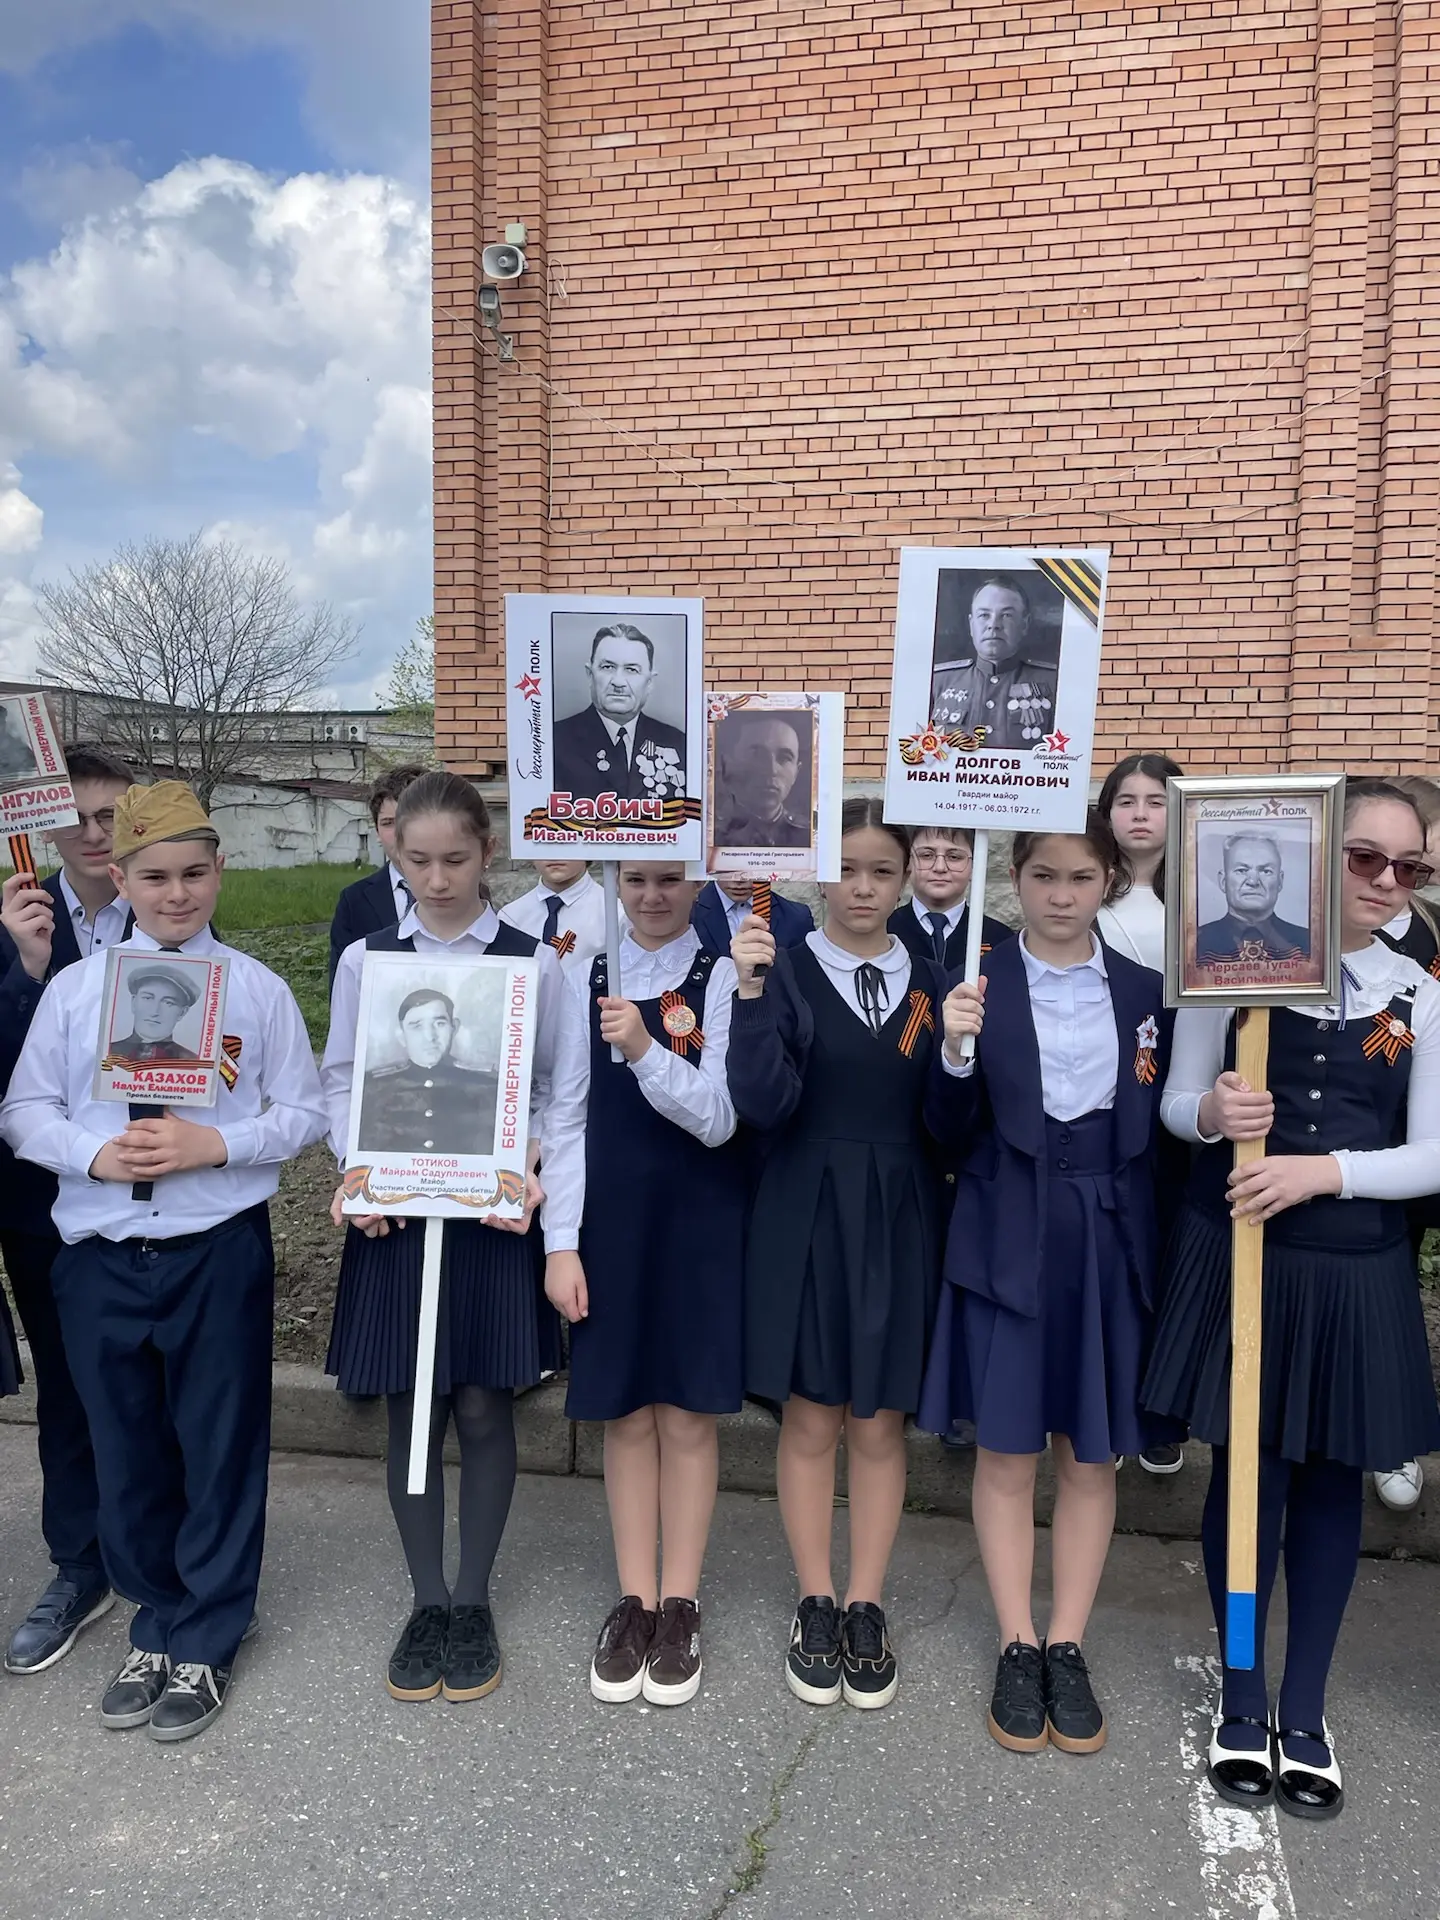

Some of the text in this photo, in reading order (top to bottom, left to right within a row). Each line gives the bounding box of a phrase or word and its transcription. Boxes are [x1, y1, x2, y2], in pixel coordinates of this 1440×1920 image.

[27, 696, 58, 772] БЕССМЕРТНЫЙ ПОЛК
[955, 756, 1021, 770] ДОЛГОВ
[906, 770, 1070, 788] ИВАН МИХАЙЛОВИЧ
[0, 785, 73, 810] НГУЛОВ
[957, 790, 1019, 801] Гвардии майор
[549, 792, 663, 819] Бабич
[934, 801, 977, 812] 14.04.1917
[984, 805, 1029, 815] 06.03.1972
[35, 818, 57, 828] ВЕСТИ
[533, 829, 678, 843] Иван Яковлевич
[1214, 974, 1293, 986] Васильевич
[203, 964, 222, 1058] БЕССМЕРТНЫЙ ПОЛК
[502, 974, 526, 1149] БЕССМЕРТНЫЙ ПОЛК
[133, 1072, 207, 1085] КАЗАХОВ
[411, 1158, 458, 1168] ТОТИКОВ
[380, 1167, 488, 1179] Майрам Садуллаевич
[370, 1183, 404, 1192] Участник
[406, 1185, 469, 1194] Сталинградской
[420, 1178, 446, 1186] Майор
